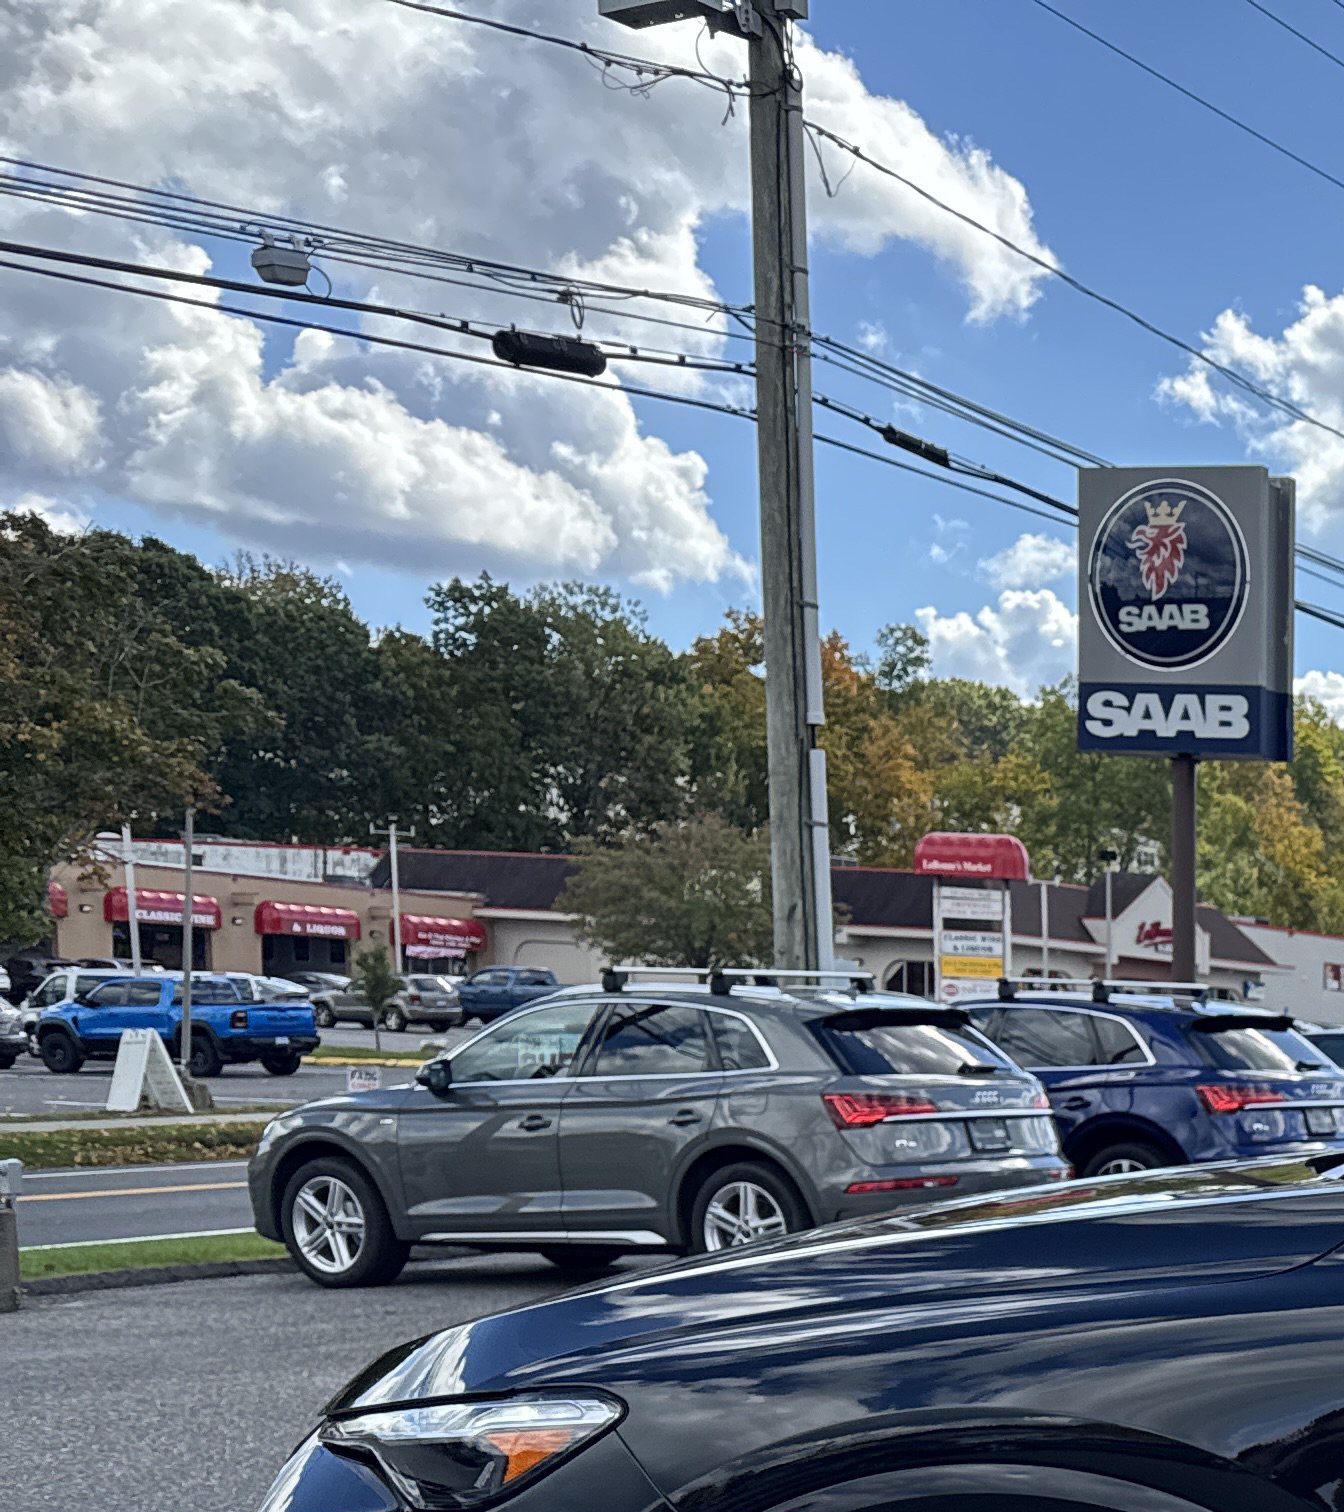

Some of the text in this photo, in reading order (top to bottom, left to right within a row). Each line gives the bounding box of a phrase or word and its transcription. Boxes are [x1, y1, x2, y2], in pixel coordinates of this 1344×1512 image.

[1118, 603, 1211, 634] SAAB
[1085, 690, 1250, 739] SAAB
[134, 909, 183, 923] CLASSIC
